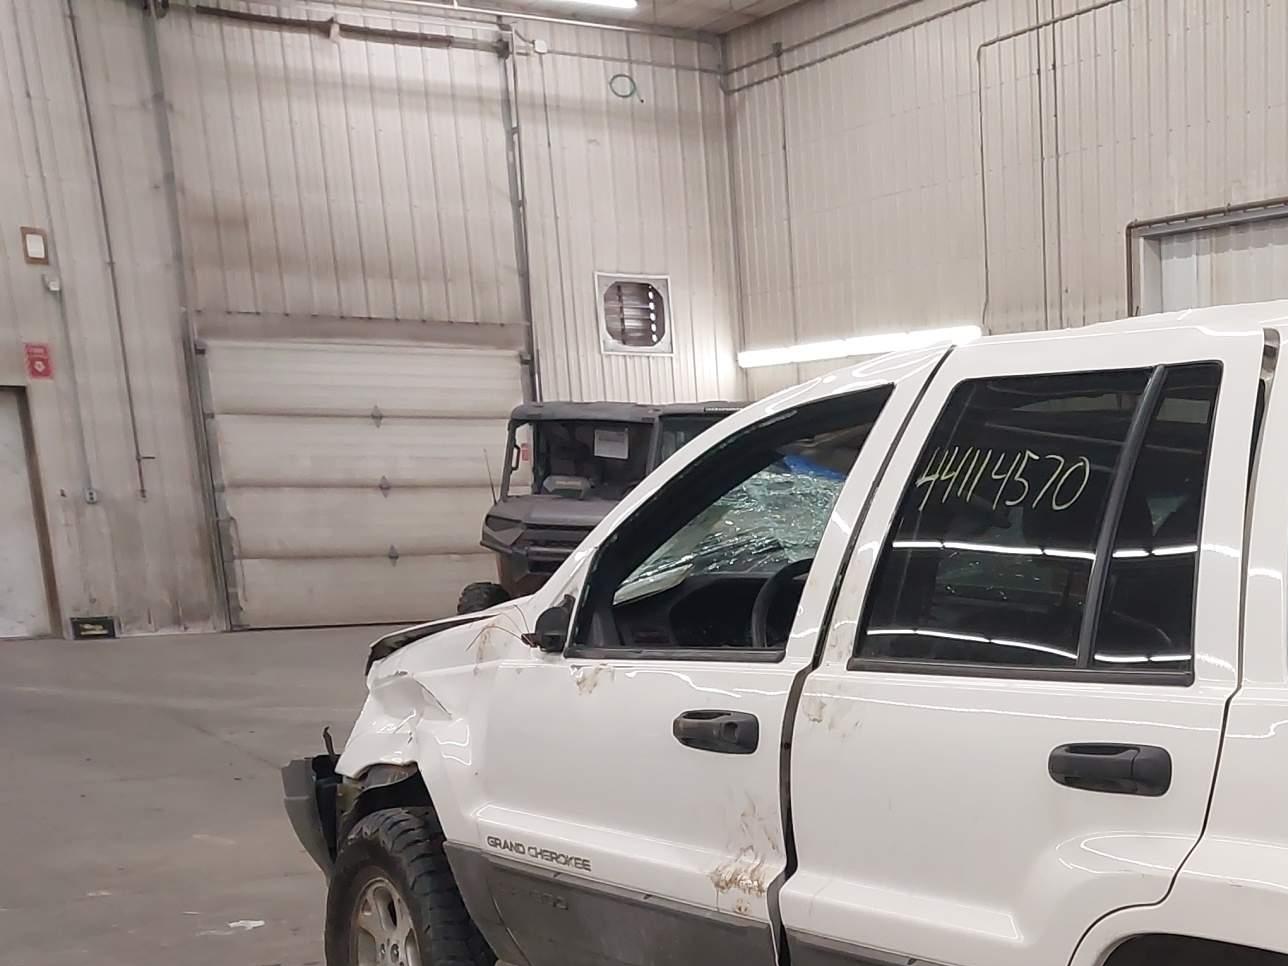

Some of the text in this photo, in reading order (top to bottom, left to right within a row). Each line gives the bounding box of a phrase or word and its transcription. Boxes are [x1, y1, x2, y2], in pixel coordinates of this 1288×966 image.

[915, 446, 1090, 512] 44114570
[487, 836, 592, 872] GRAND CHEROKEE
